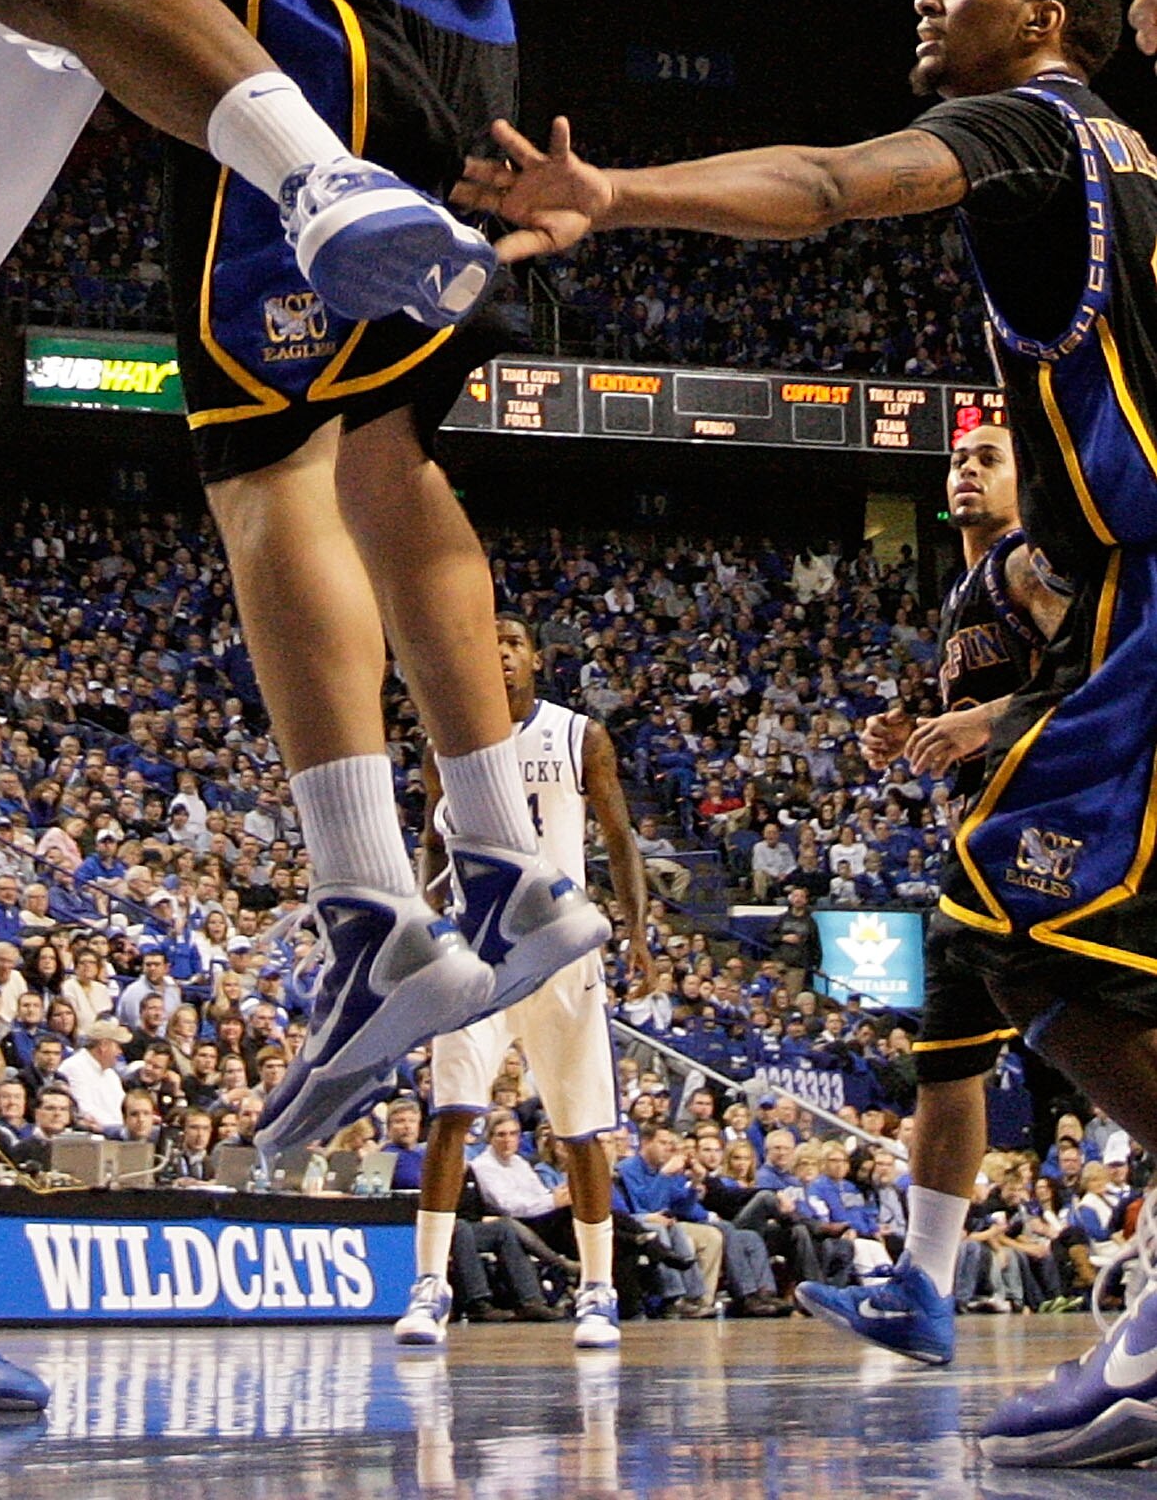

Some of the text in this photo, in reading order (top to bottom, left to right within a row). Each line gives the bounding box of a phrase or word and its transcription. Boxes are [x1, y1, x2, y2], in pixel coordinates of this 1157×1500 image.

[656, 52, 711, 81] 219
[41, 355, 180, 394] SUBWAY
[530, 370, 560, 384] OUTS
[516, 383, 544, 396] LEFT
[590, 373, 664, 394] KENTUCKY
[896, 389, 926, 404] OUTS
[954, 392, 975, 406] PLY
[507, 400, 540, 414] TEAM
[883, 402, 910, 416] LEFT
[504, 413, 542, 428] FOULS
[876, 419, 907, 433] TEAM
[873, 432, 909, 447] FOULS
[524, 760, 564, 783] CKY
[24, 1223, 375, 1311] WILDCATS
